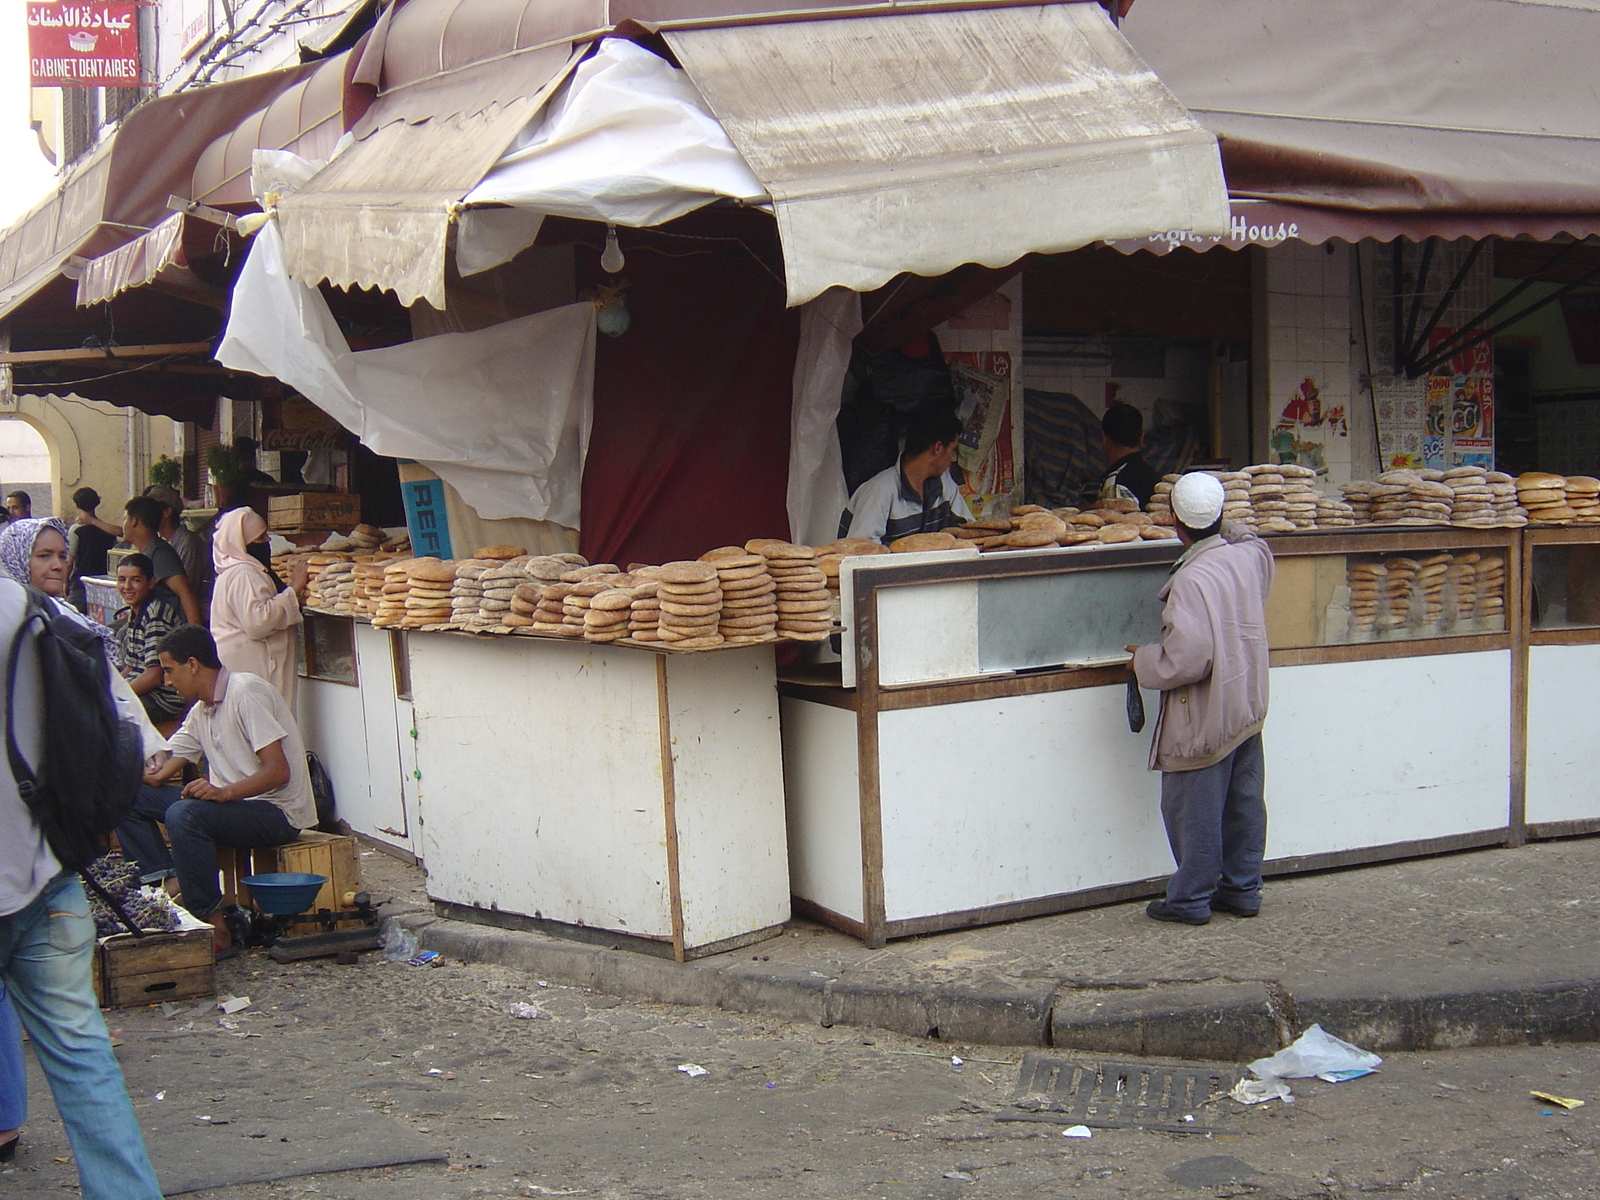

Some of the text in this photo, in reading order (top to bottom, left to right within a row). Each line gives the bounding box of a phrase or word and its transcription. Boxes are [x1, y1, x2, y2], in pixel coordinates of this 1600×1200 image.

[27, 4, 131, 35] عيادة الأسنان
[31, 58, 136, 77] CABINET DENTAIRES
[1230, 215, 1299, 241] House
[413, 485, 441, 559] REF
